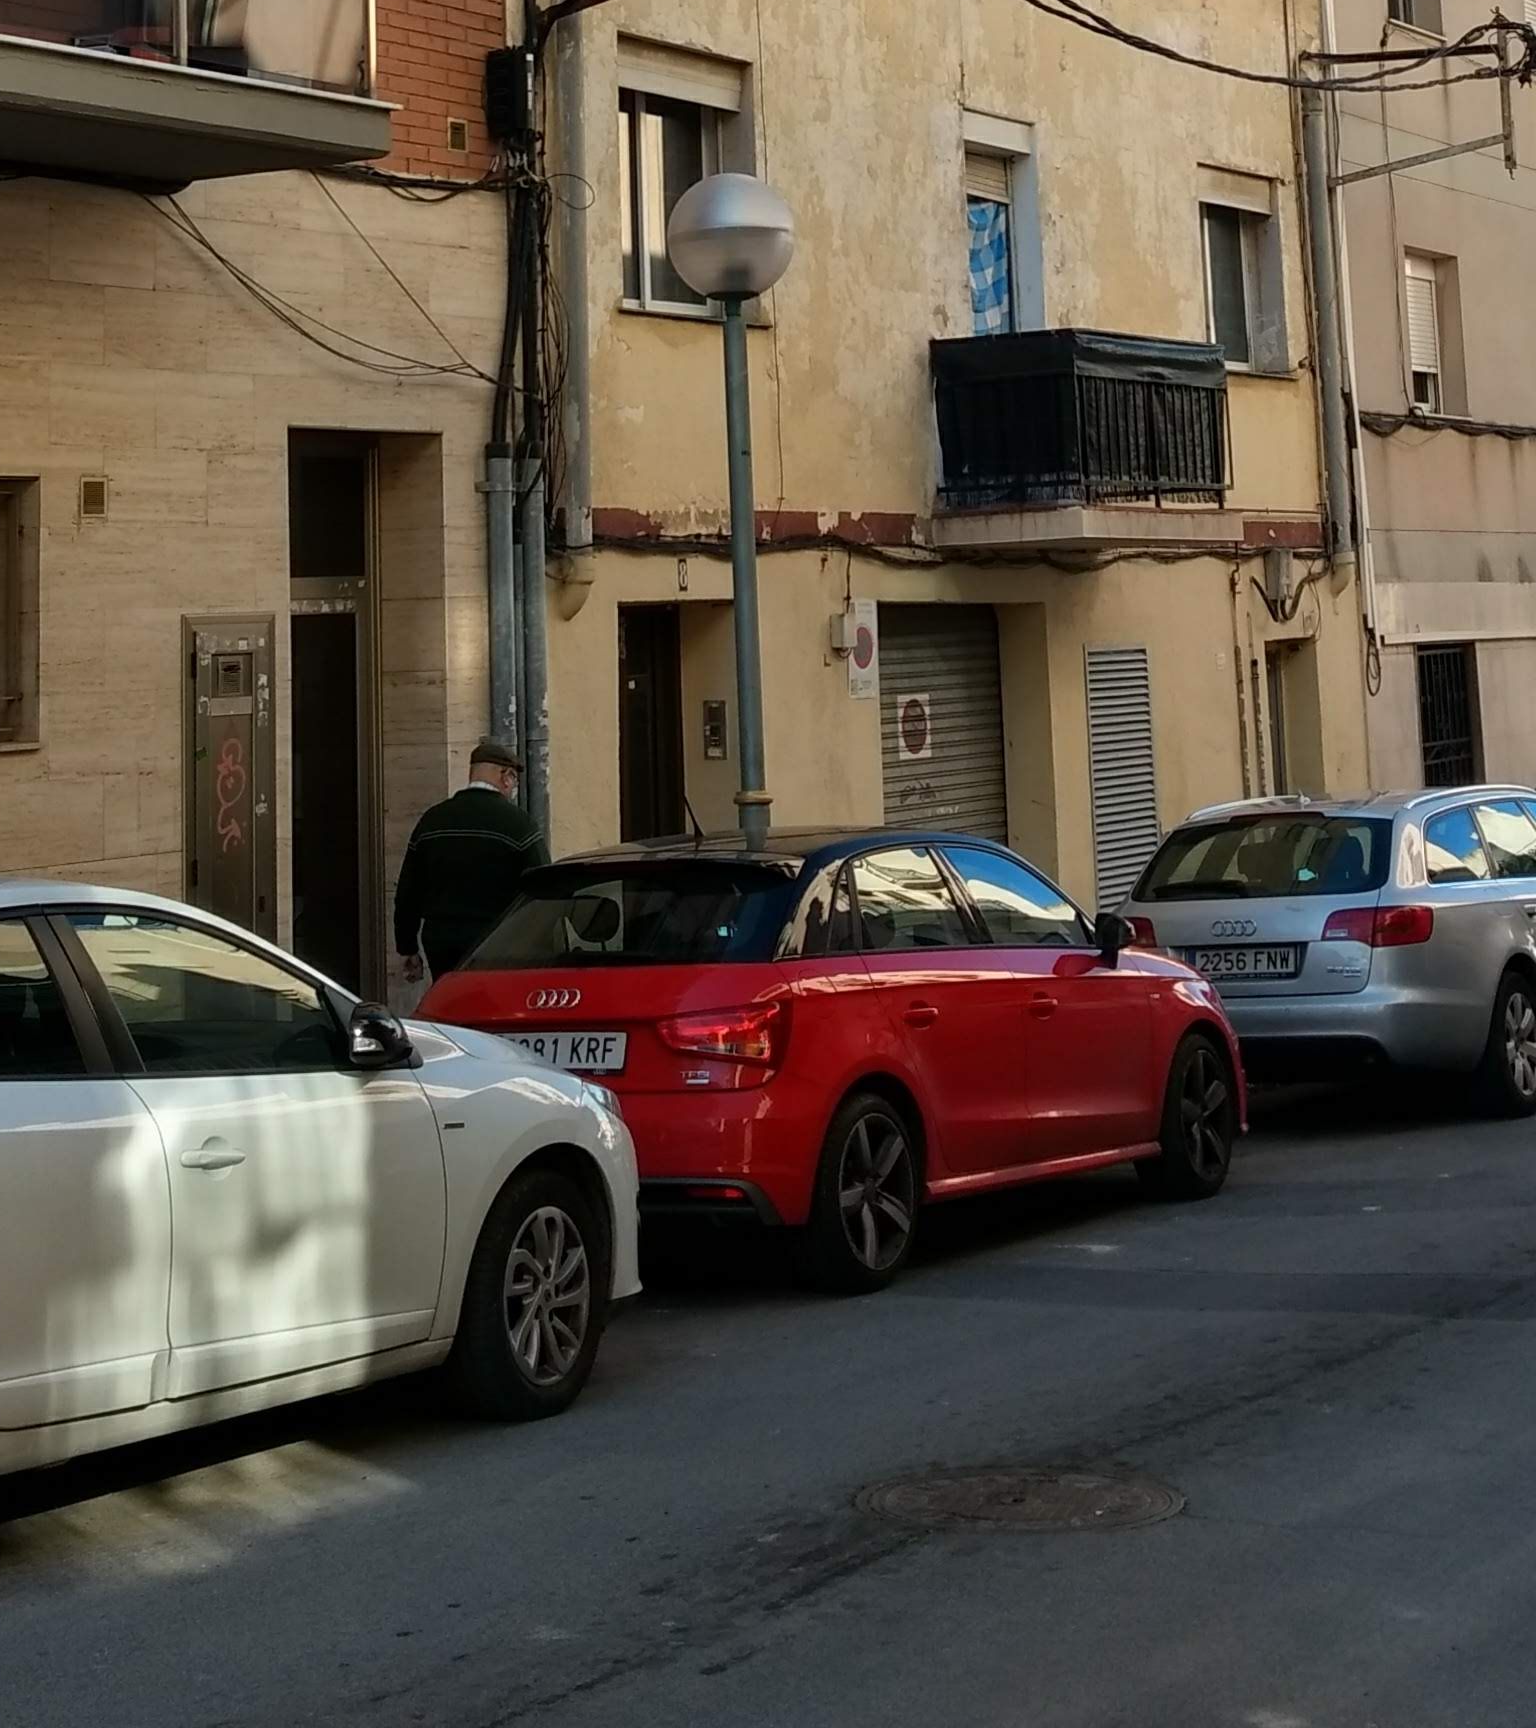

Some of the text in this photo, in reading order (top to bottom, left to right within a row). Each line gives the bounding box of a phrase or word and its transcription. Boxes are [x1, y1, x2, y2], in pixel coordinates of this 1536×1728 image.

[679, 562, 688, 587] 8
[1200, 950, 1290, 972] 2256 FNW
[569, 1037, 617, 1064] KRF
